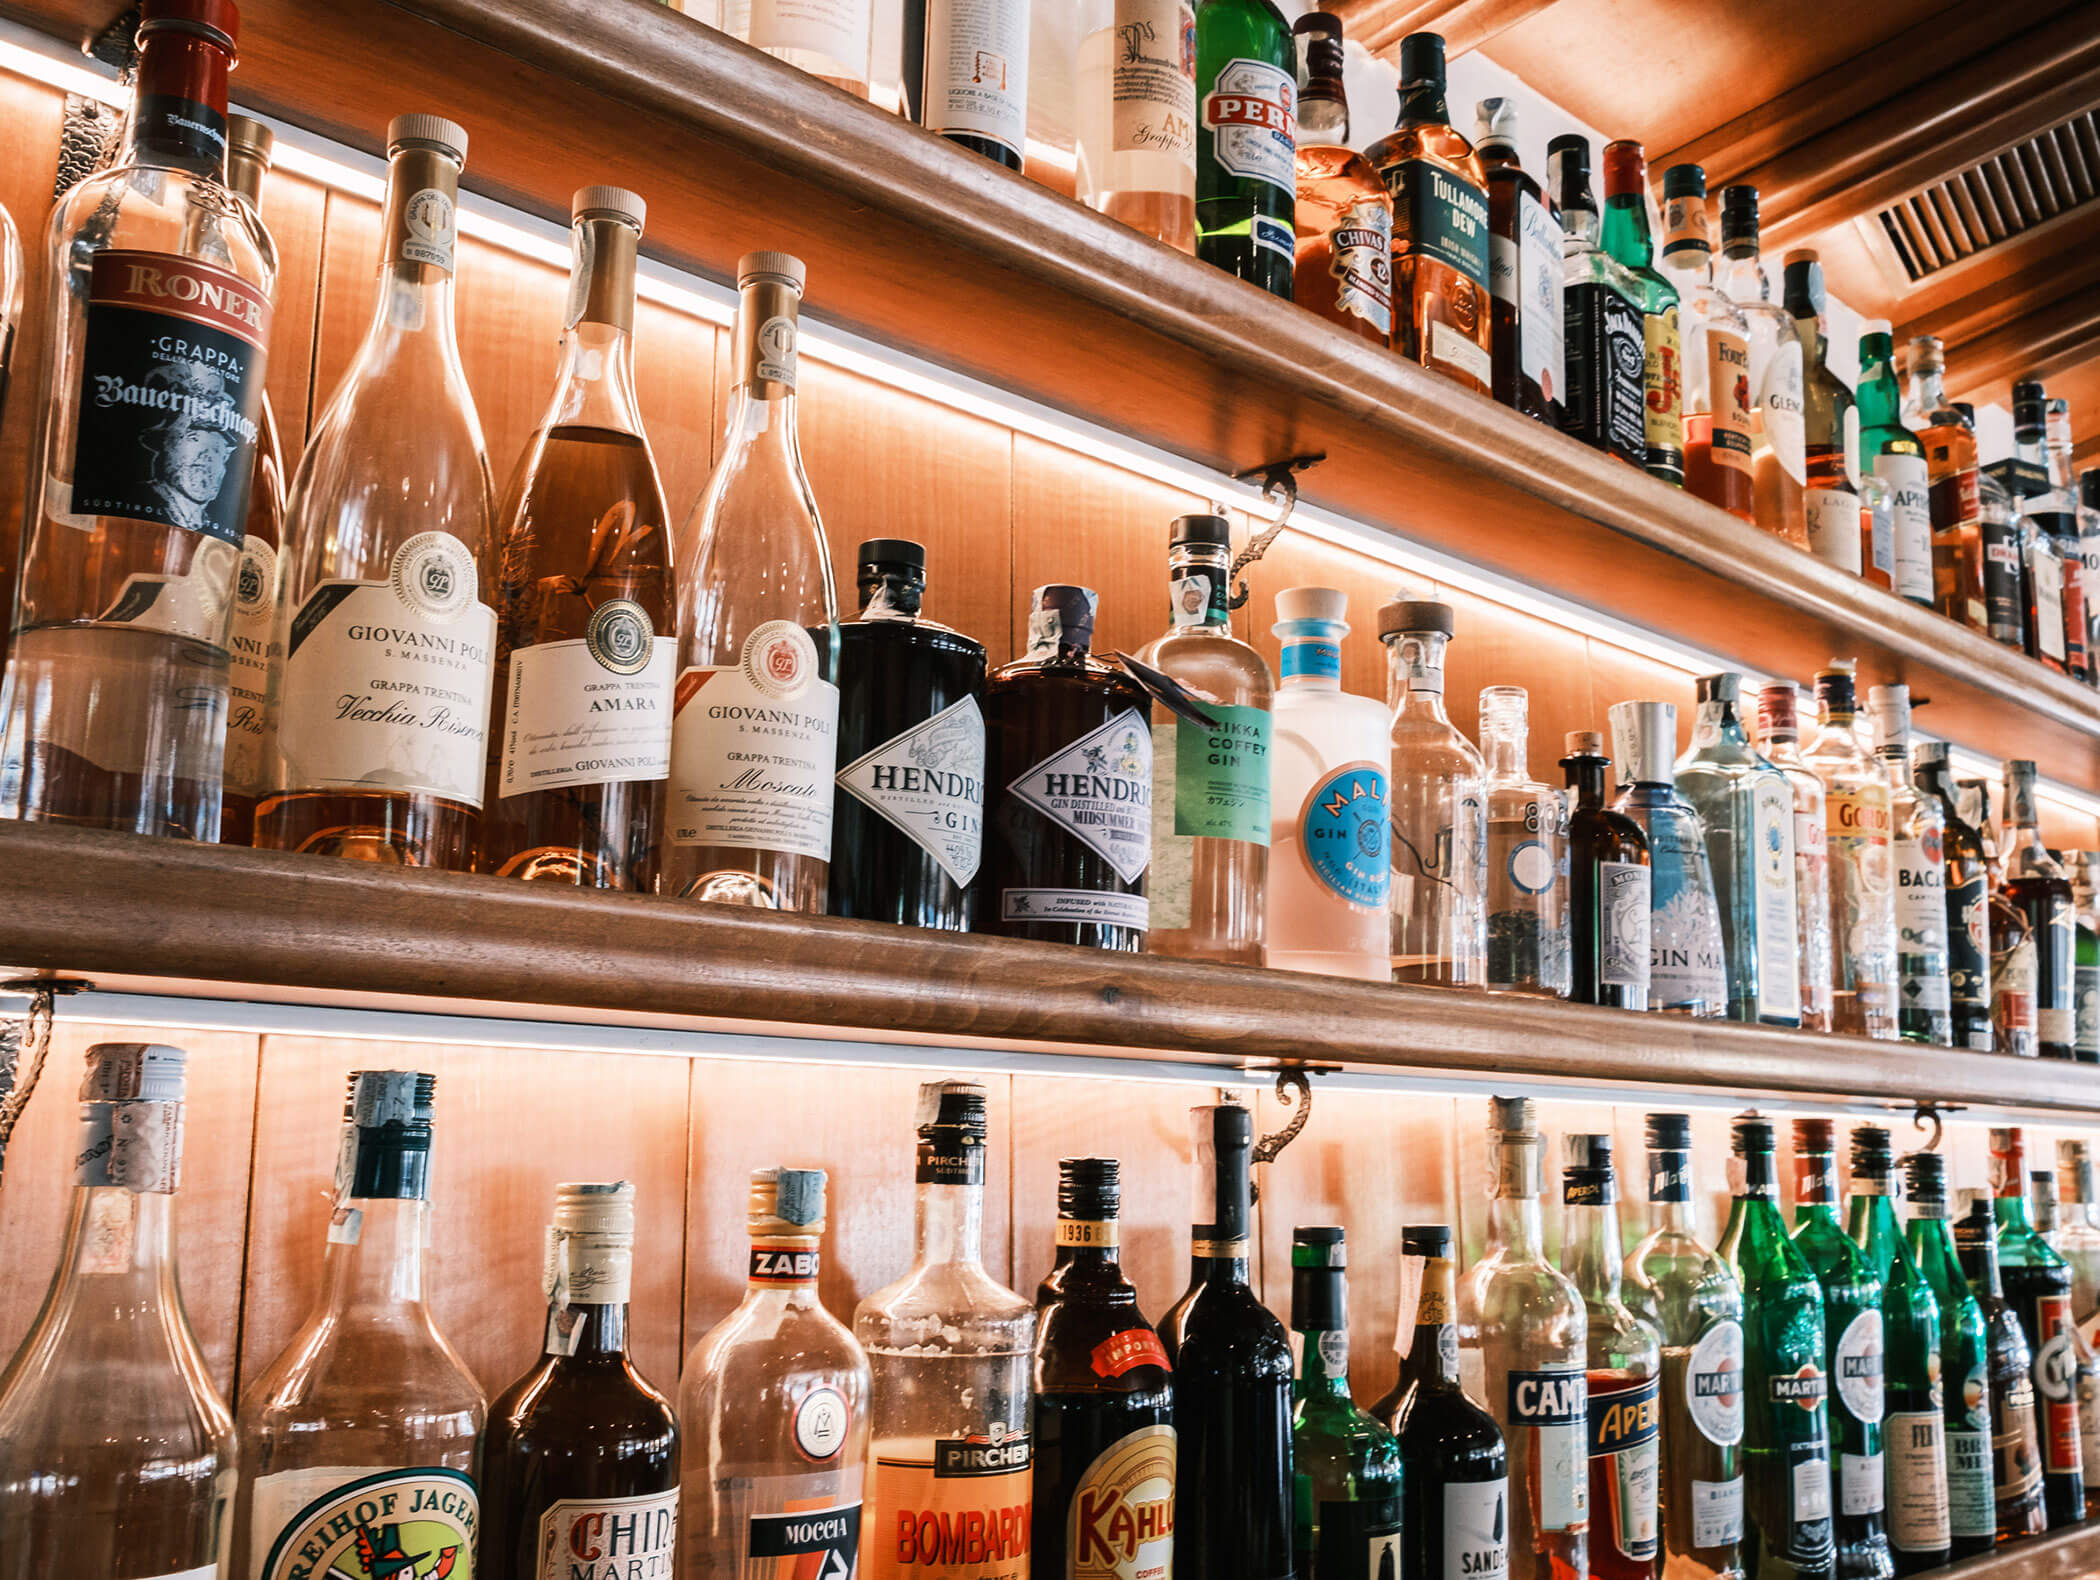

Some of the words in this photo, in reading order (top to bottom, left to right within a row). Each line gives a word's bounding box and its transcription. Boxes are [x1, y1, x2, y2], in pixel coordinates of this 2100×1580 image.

[1452, 207, 1476, 239] DEW
[1336, 231, 1384, 251] CHIVAS
[126, 264, 265, 333] RONER
[158, 336, 240, 373] GRAPPA
[348, 624, 456, 654] GIOVANNI
[402, 650, 468, 672] MASSENZA
[370, 679, 421, 696] GRAPPA
[583, 683, 622, 693] GRAPPA
[335, 694, 417, 727] Vecchia
[588, 697, 657, 713] AMARA
[708, 705, 800, 726] GIOVANNI
[1208, 737, 1267, 757] COFFEY
[575, 758, 635, 772] GIOVANNI
[727, 751, 770, 764] GRAPPA
[1208, 753, 1241, 768] GIN
[720, 768, 818, 799] Moscato
[1314, 827, 1348, 840] GIN
[1063, 1224, 1092, 1242] 1936
[784, 1517, 848, 1545] MOCCIA
